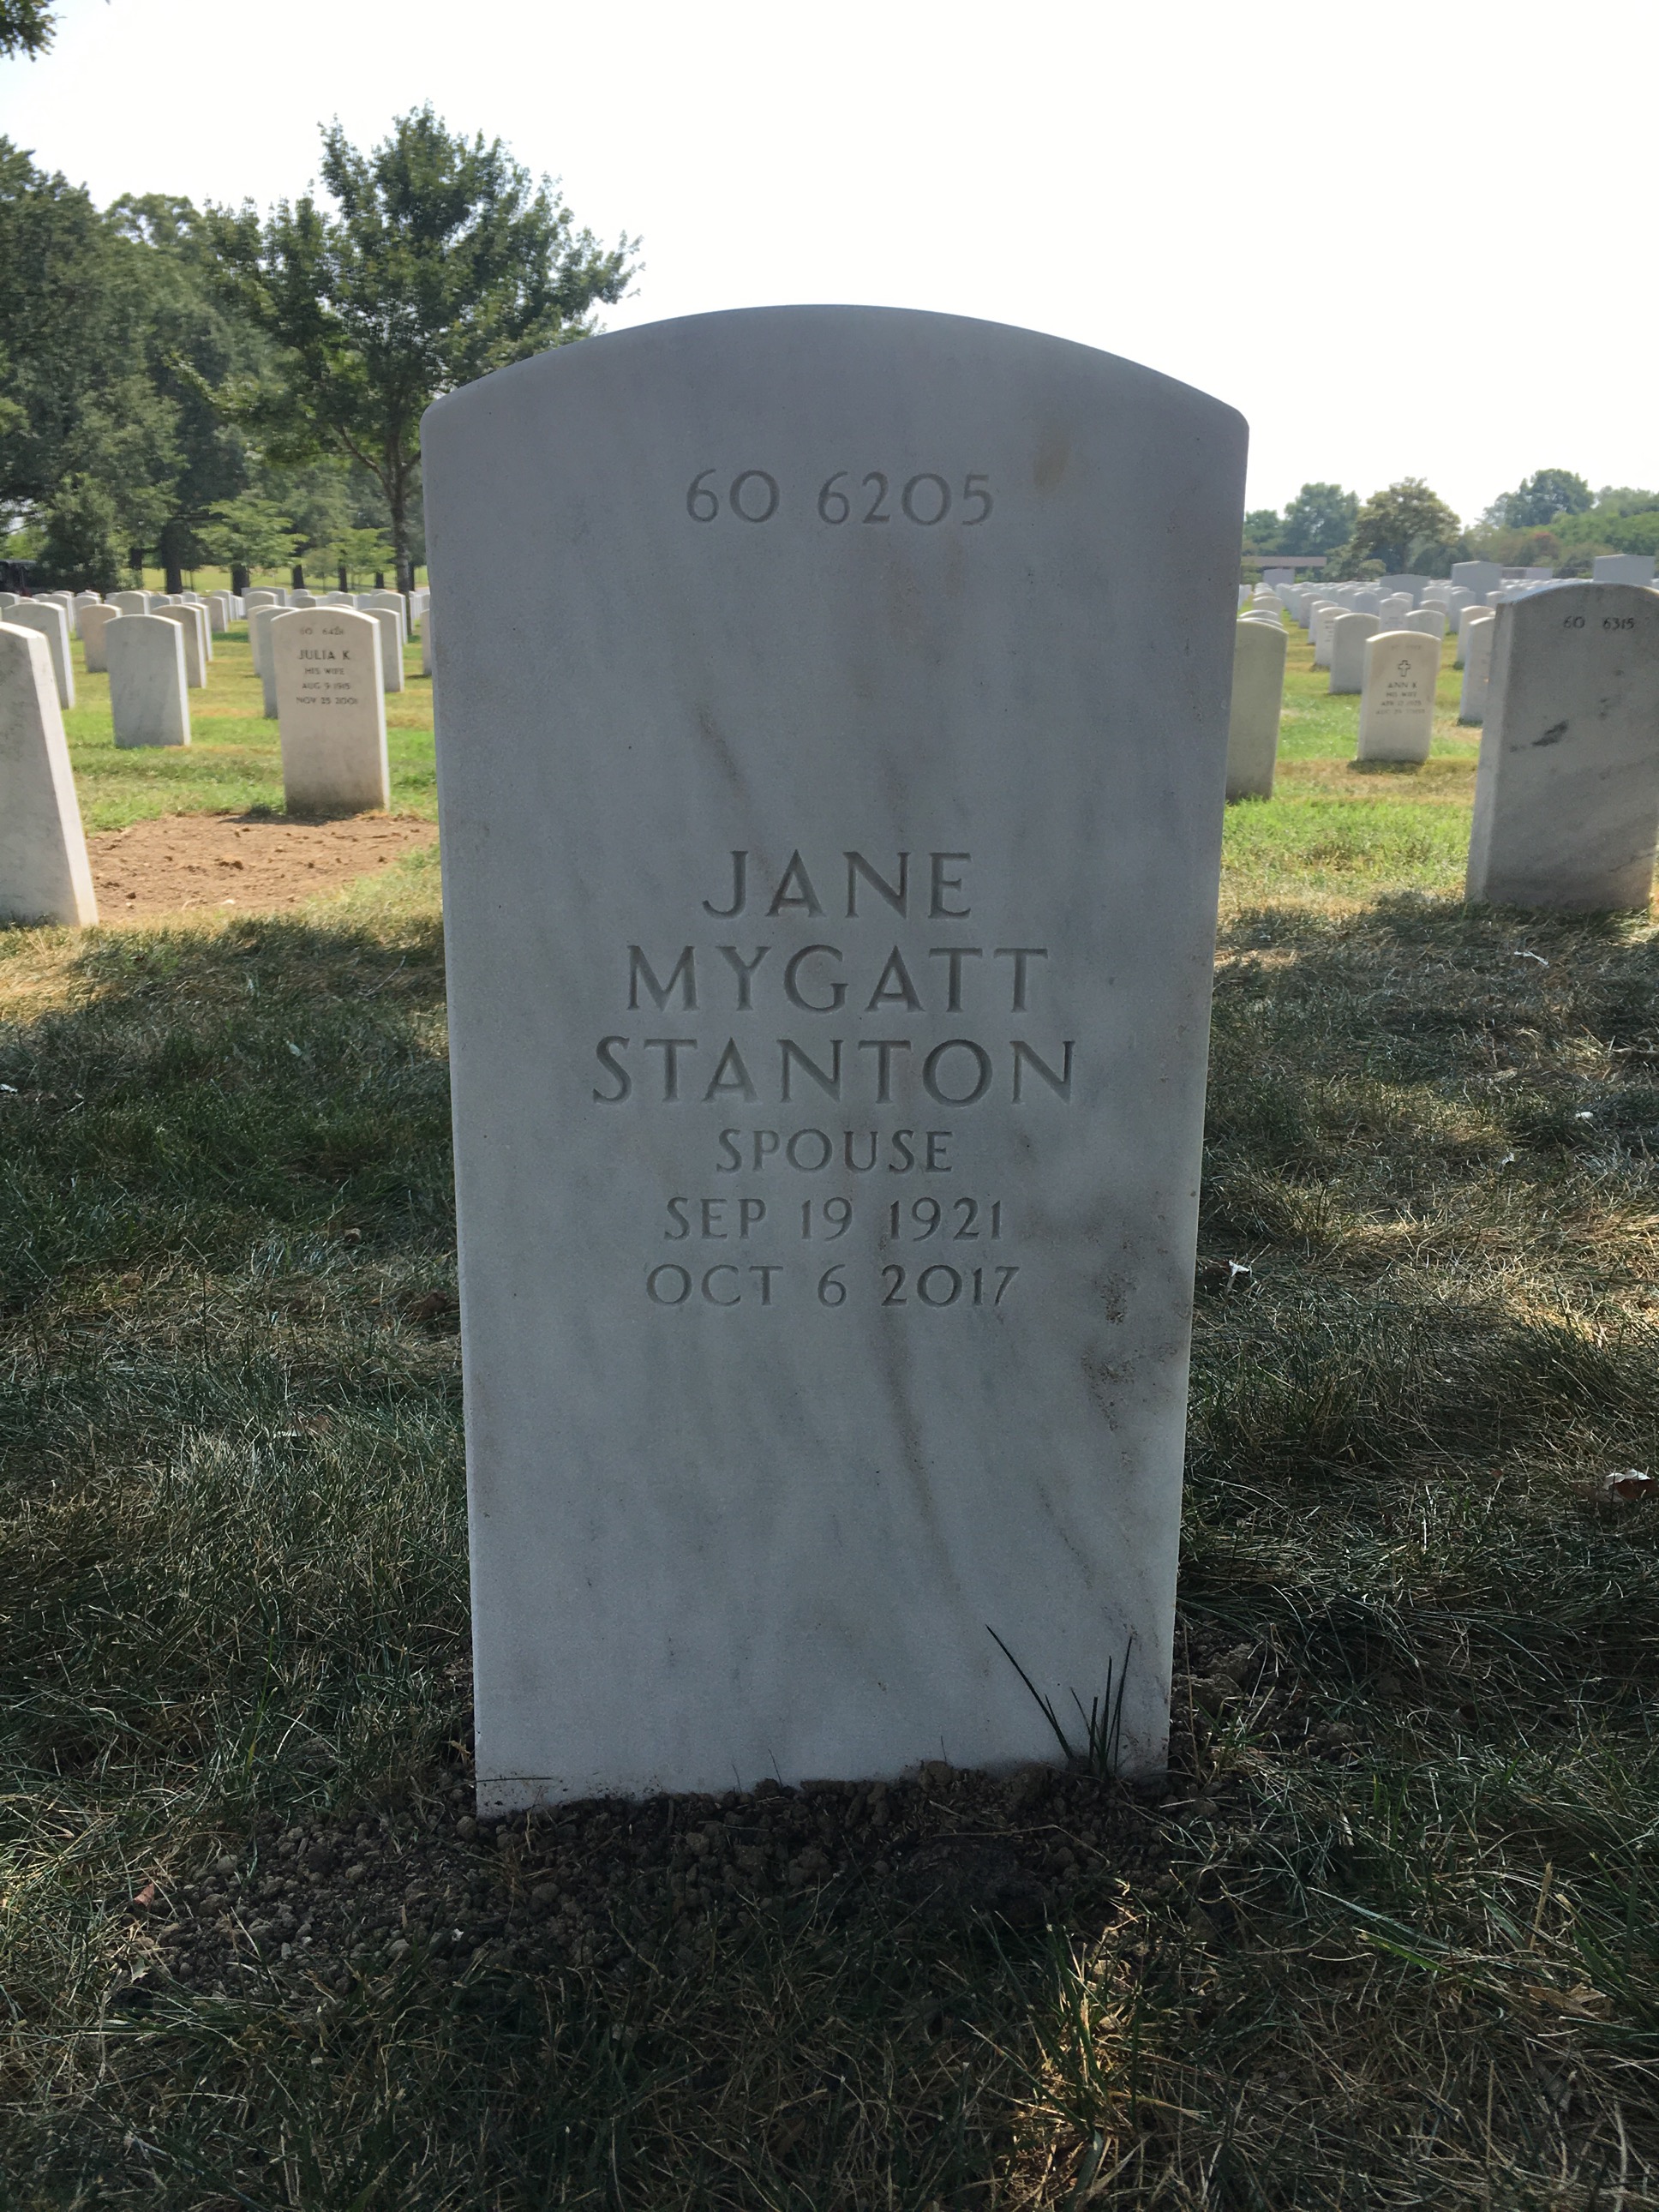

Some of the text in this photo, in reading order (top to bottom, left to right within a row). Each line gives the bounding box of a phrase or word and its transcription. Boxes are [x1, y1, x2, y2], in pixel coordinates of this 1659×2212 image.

[686, 469, 994, 526] 60 6205
[1563, 616, 1635, 630] 60 6315
[298, 650, 351, 660] JULIA K
[701, 849, 972, 920] JANE
[626, 944, 1050, 1014] MYGATT
[592, 1034, 1076, 1107] STANTON
[716, 1128, 953, 1174] SPOUSE
[663, 1196, 1002, 1242] SEP 19 1921
[645, 1263, 1020, 1308] OCT 6 2017
